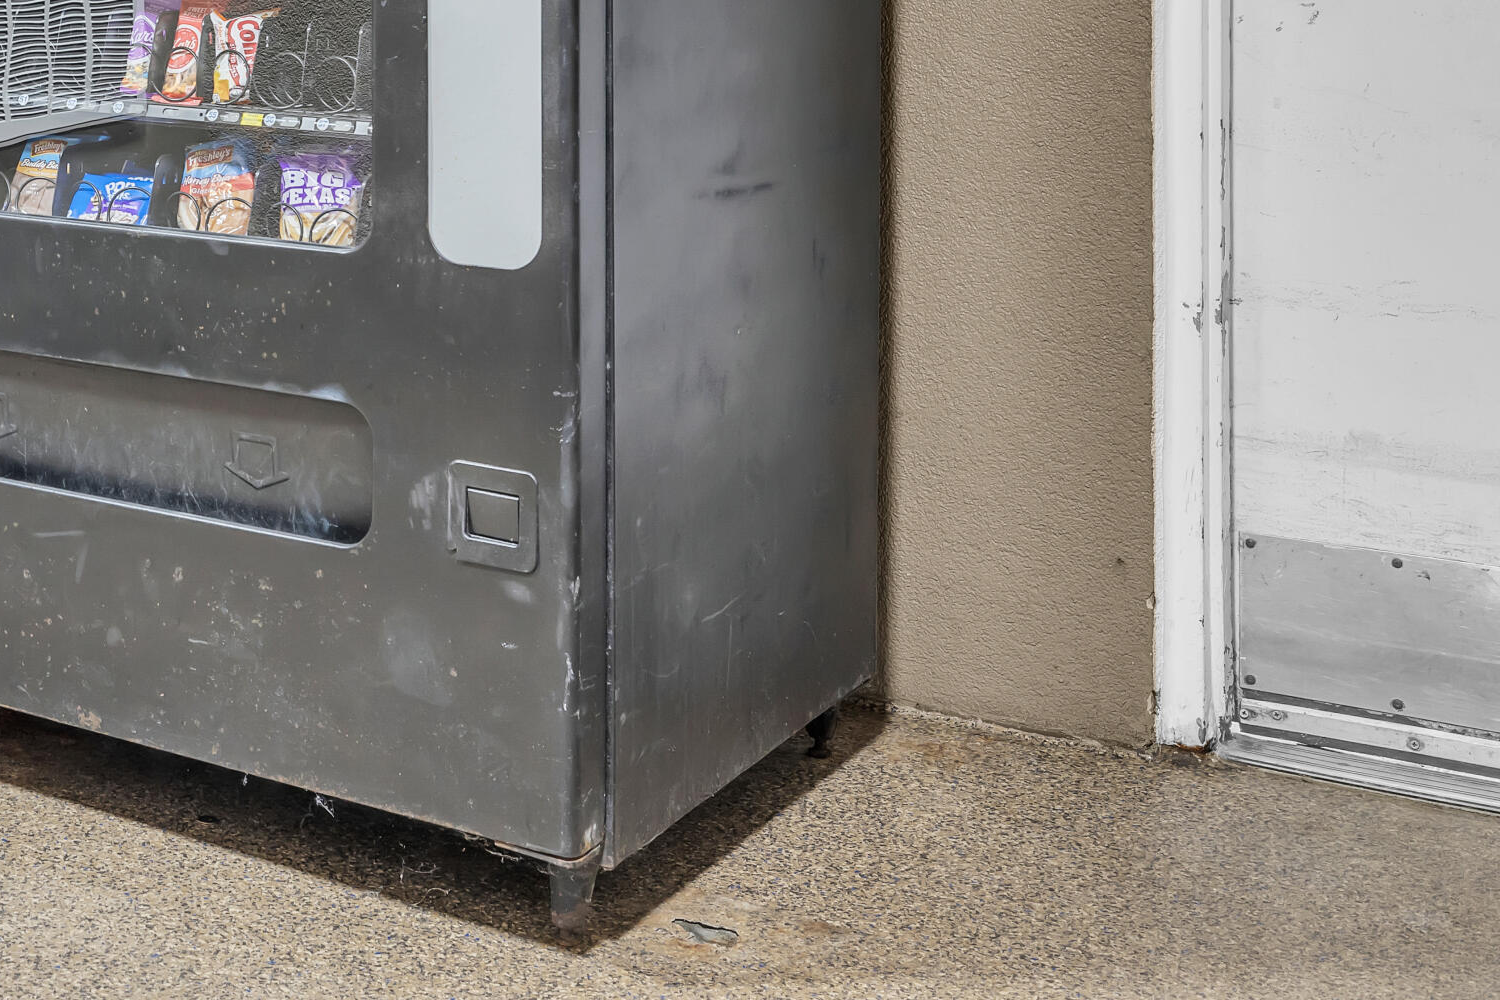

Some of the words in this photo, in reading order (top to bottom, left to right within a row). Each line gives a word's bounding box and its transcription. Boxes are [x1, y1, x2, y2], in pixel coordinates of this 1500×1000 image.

[20, 158, 46, 170] Buddy
[188, 148, 230, 167] Freshley's
[282, 169, 345, 189] BIG
[282, 187, 351, 205] TEXAS
